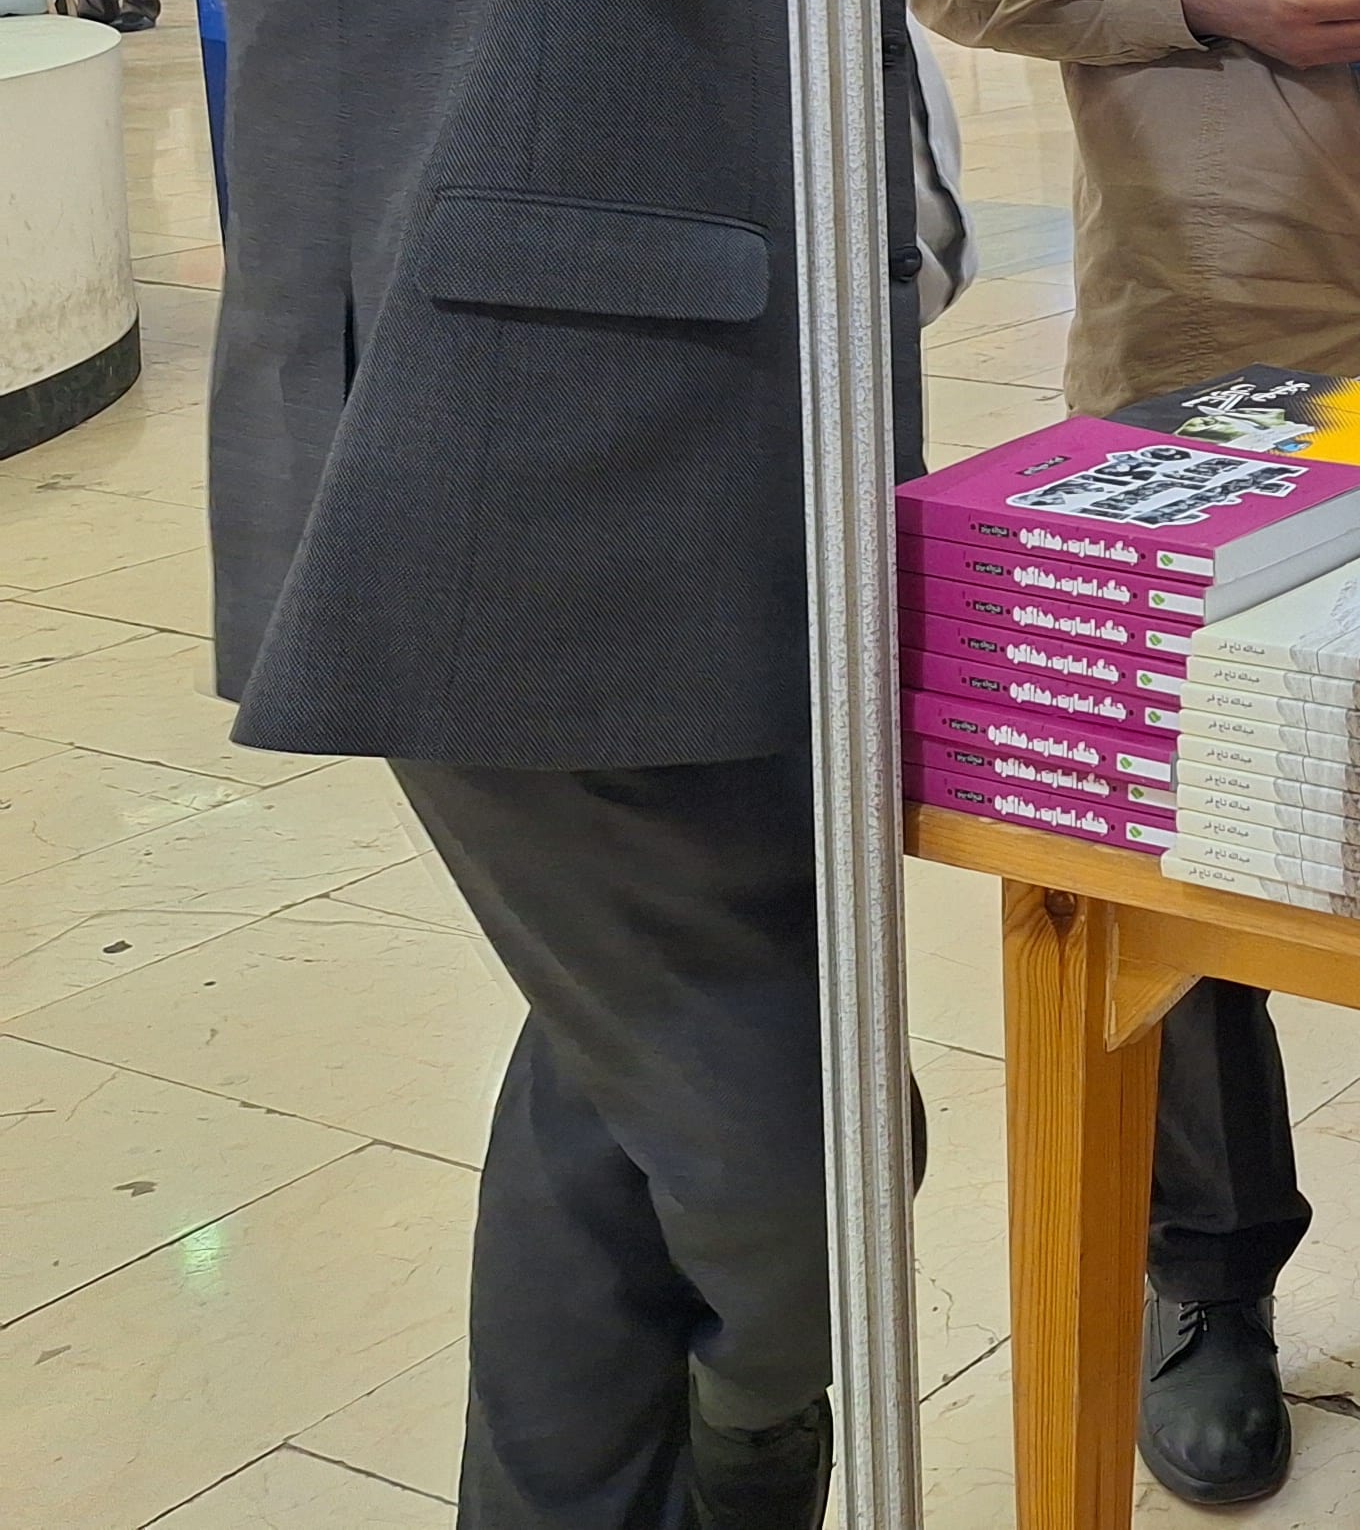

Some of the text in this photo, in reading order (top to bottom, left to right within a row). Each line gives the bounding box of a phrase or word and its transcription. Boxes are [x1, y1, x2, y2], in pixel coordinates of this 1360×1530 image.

[1020, 529, 1062, 552] مذاکره
[1014, 566, 1055, 589] مذاکره
[1014, 606, 1054, 629] مذاکره
[1007, 644, 1046, 667] مذاکره
[1010, 683, 1051, 706] مذاکره
[988, 725, 1027, 748] مذاکره
[995, 758, 1035, 781] مذاکره
[995, 795, 1035, 818] مذاکره
